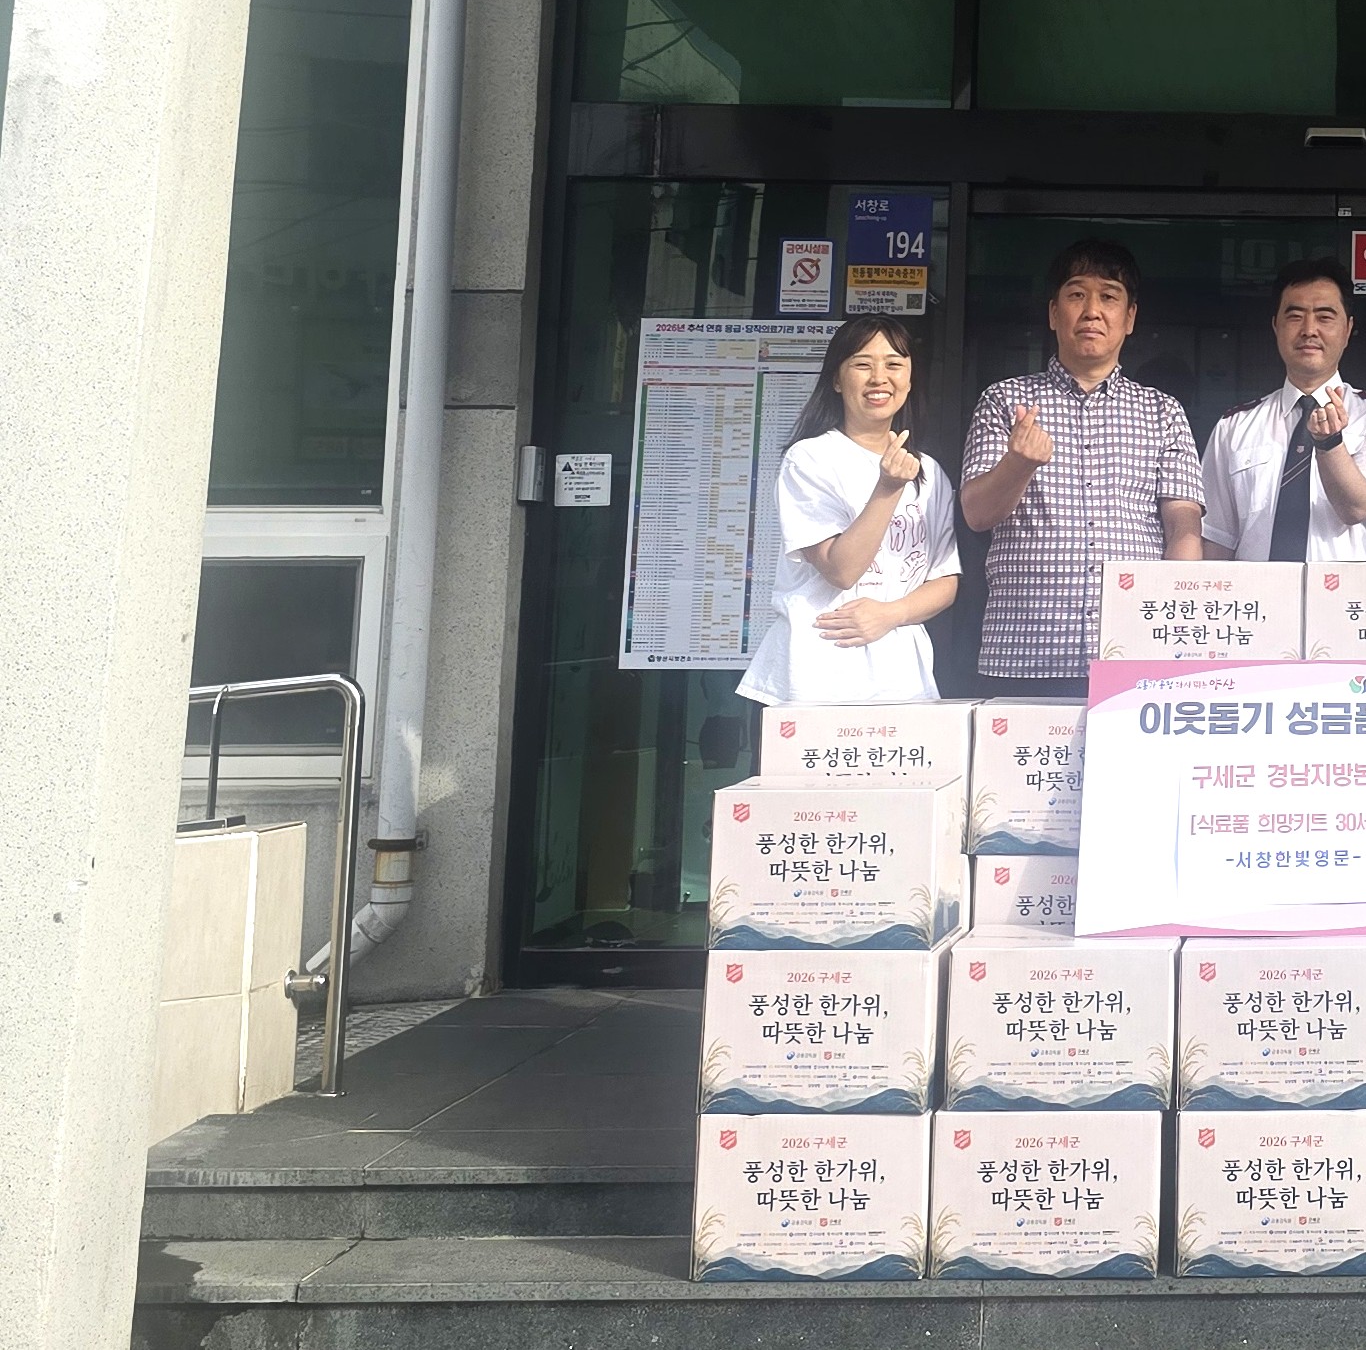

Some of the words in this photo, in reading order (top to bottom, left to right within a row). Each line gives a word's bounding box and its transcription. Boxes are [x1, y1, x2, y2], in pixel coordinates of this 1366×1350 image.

[855, 199, 890, 214] 서창로
[786, 243, 830, 255] 금연시설물
[886, 231, 925, 259] 194
[655, 323, 686, 333] 2026년
[688, 324, 704, 333] 추석
[706, 324, 722, 333] 연휴
[797, 325, 805, 334] 및
[807, 325, 824, 334] 약국
[1173, 580, 1200, 591] 2026
[1201, 580, 1233, 592] 구세군
[1139, 599, 1199, 621] 풍성한
[1203, 600, 1266, 623] 한가위,
[1152, 624, 1211, 646] 따뜻한
[1215, 624, 1254, 646] 나눔
[1209, 678, 1235, 690] 양산
[1139, 700, 1274, 737] 이웃돕기
[836, 727, 864, 738] 2026
[865, 725, 898, 738] 구세군
[1048, 725, 1074, 736] 2026
[800, 746, 862, 769] 풍성한
[866, 745, 932, 768] 한가위,
[1012, 745, 1073, 767] 풍성한
[1025, 769, 1083, 792] 따뜻한
[1191, 763, 1257, 790] 구세군
[793, 811, 822, 822] 2026
[823, 809, 858, 823] 구세군
[1190, 811, 1249, 835] [식료품
[1258, 812, 1328, 833] 희망키트
[755, 832, 820, 855] 풍성한
[825, 831, 894, 856] 한가위,
[769, 859, 833, 883] 따뜻한
[838, 859, 881, 883] 나눔
[1015, 894, 1076, 917] 풍성한
[786, 972, 816, 983] 2026
[817, 971, 853, 984] 구세군
[1029, 969, 1058, 981] 2026
[1060, 968, 1095, 981] 구세군
[748, 993, 814, 1017] 풍성한
[818, 993, 888, 1019] 한가위,
[991, 990, 1057, 1015] 풍성한
[1061, 990, 1131, 1015] 한가위,
[762, 1021, 827, 1045] 따뜻한
[832, 1021, 875, 1045] 나눔
[1006, 1018, 1070, 1043] 따뜻한
[1076, 1018, 1118, 1042] 나눔
[781, 1137, 811, 1149] 2026
[812, 1135, 848, 1150] 구세군
[1259, 1136, 1288, 1147] 2026
[1289, 1134, 1324, 1148] 구세군
[742, 1159, 809, 1184] 풍성한
[813, 1158, 885, 1184] 한가위,
[1221, 1157, 1287, 1182] 풍성한
[1291, 1157, 1362, 1183] 한가위,
[756, 1187, 822, 1212] 따뜻한
[828, 1187, 871, 1211] 나눔
[1235, 1186, 1301, 1211] 따뜻한
[1306, 1185, 1349, 1210] 나눔
